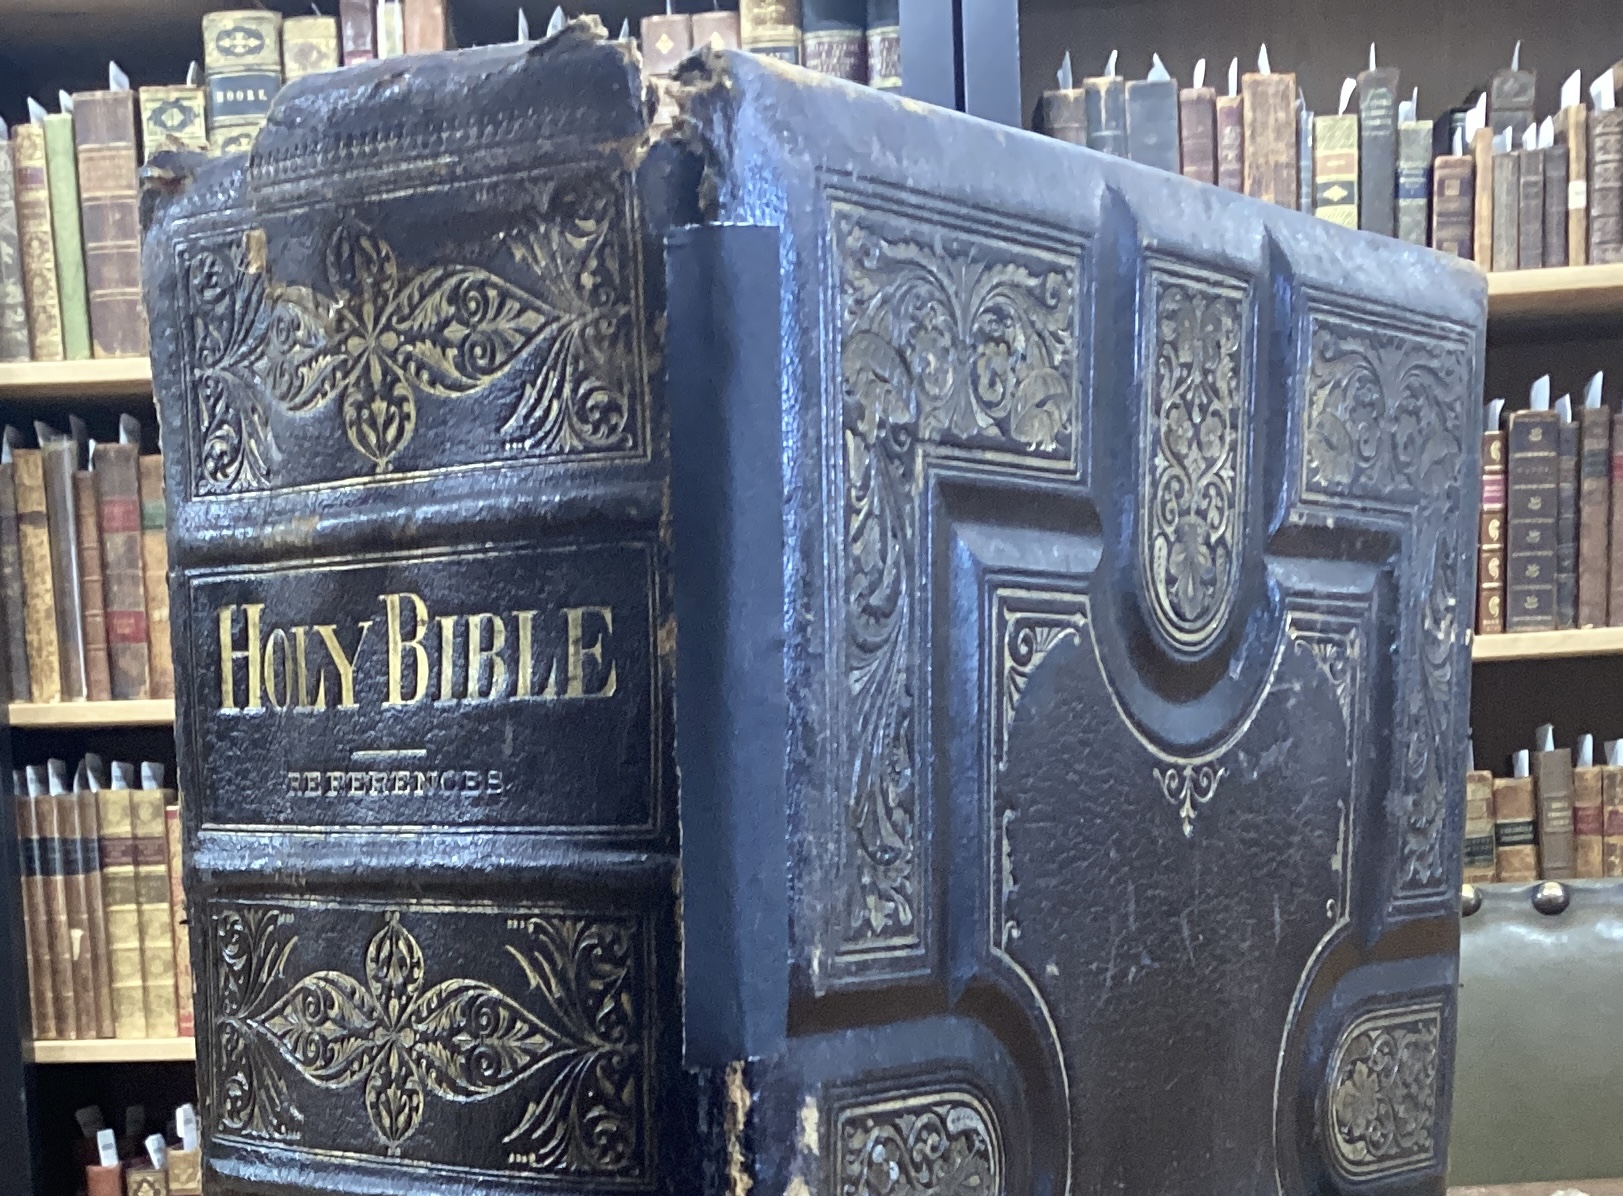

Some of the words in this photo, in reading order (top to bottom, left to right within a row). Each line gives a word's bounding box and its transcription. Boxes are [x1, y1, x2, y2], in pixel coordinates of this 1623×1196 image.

[217, 603, 372, 715] HOLY
[379, 592, 617, 711] BIBLE
[285, 769, 504, 798] REFERENCES
